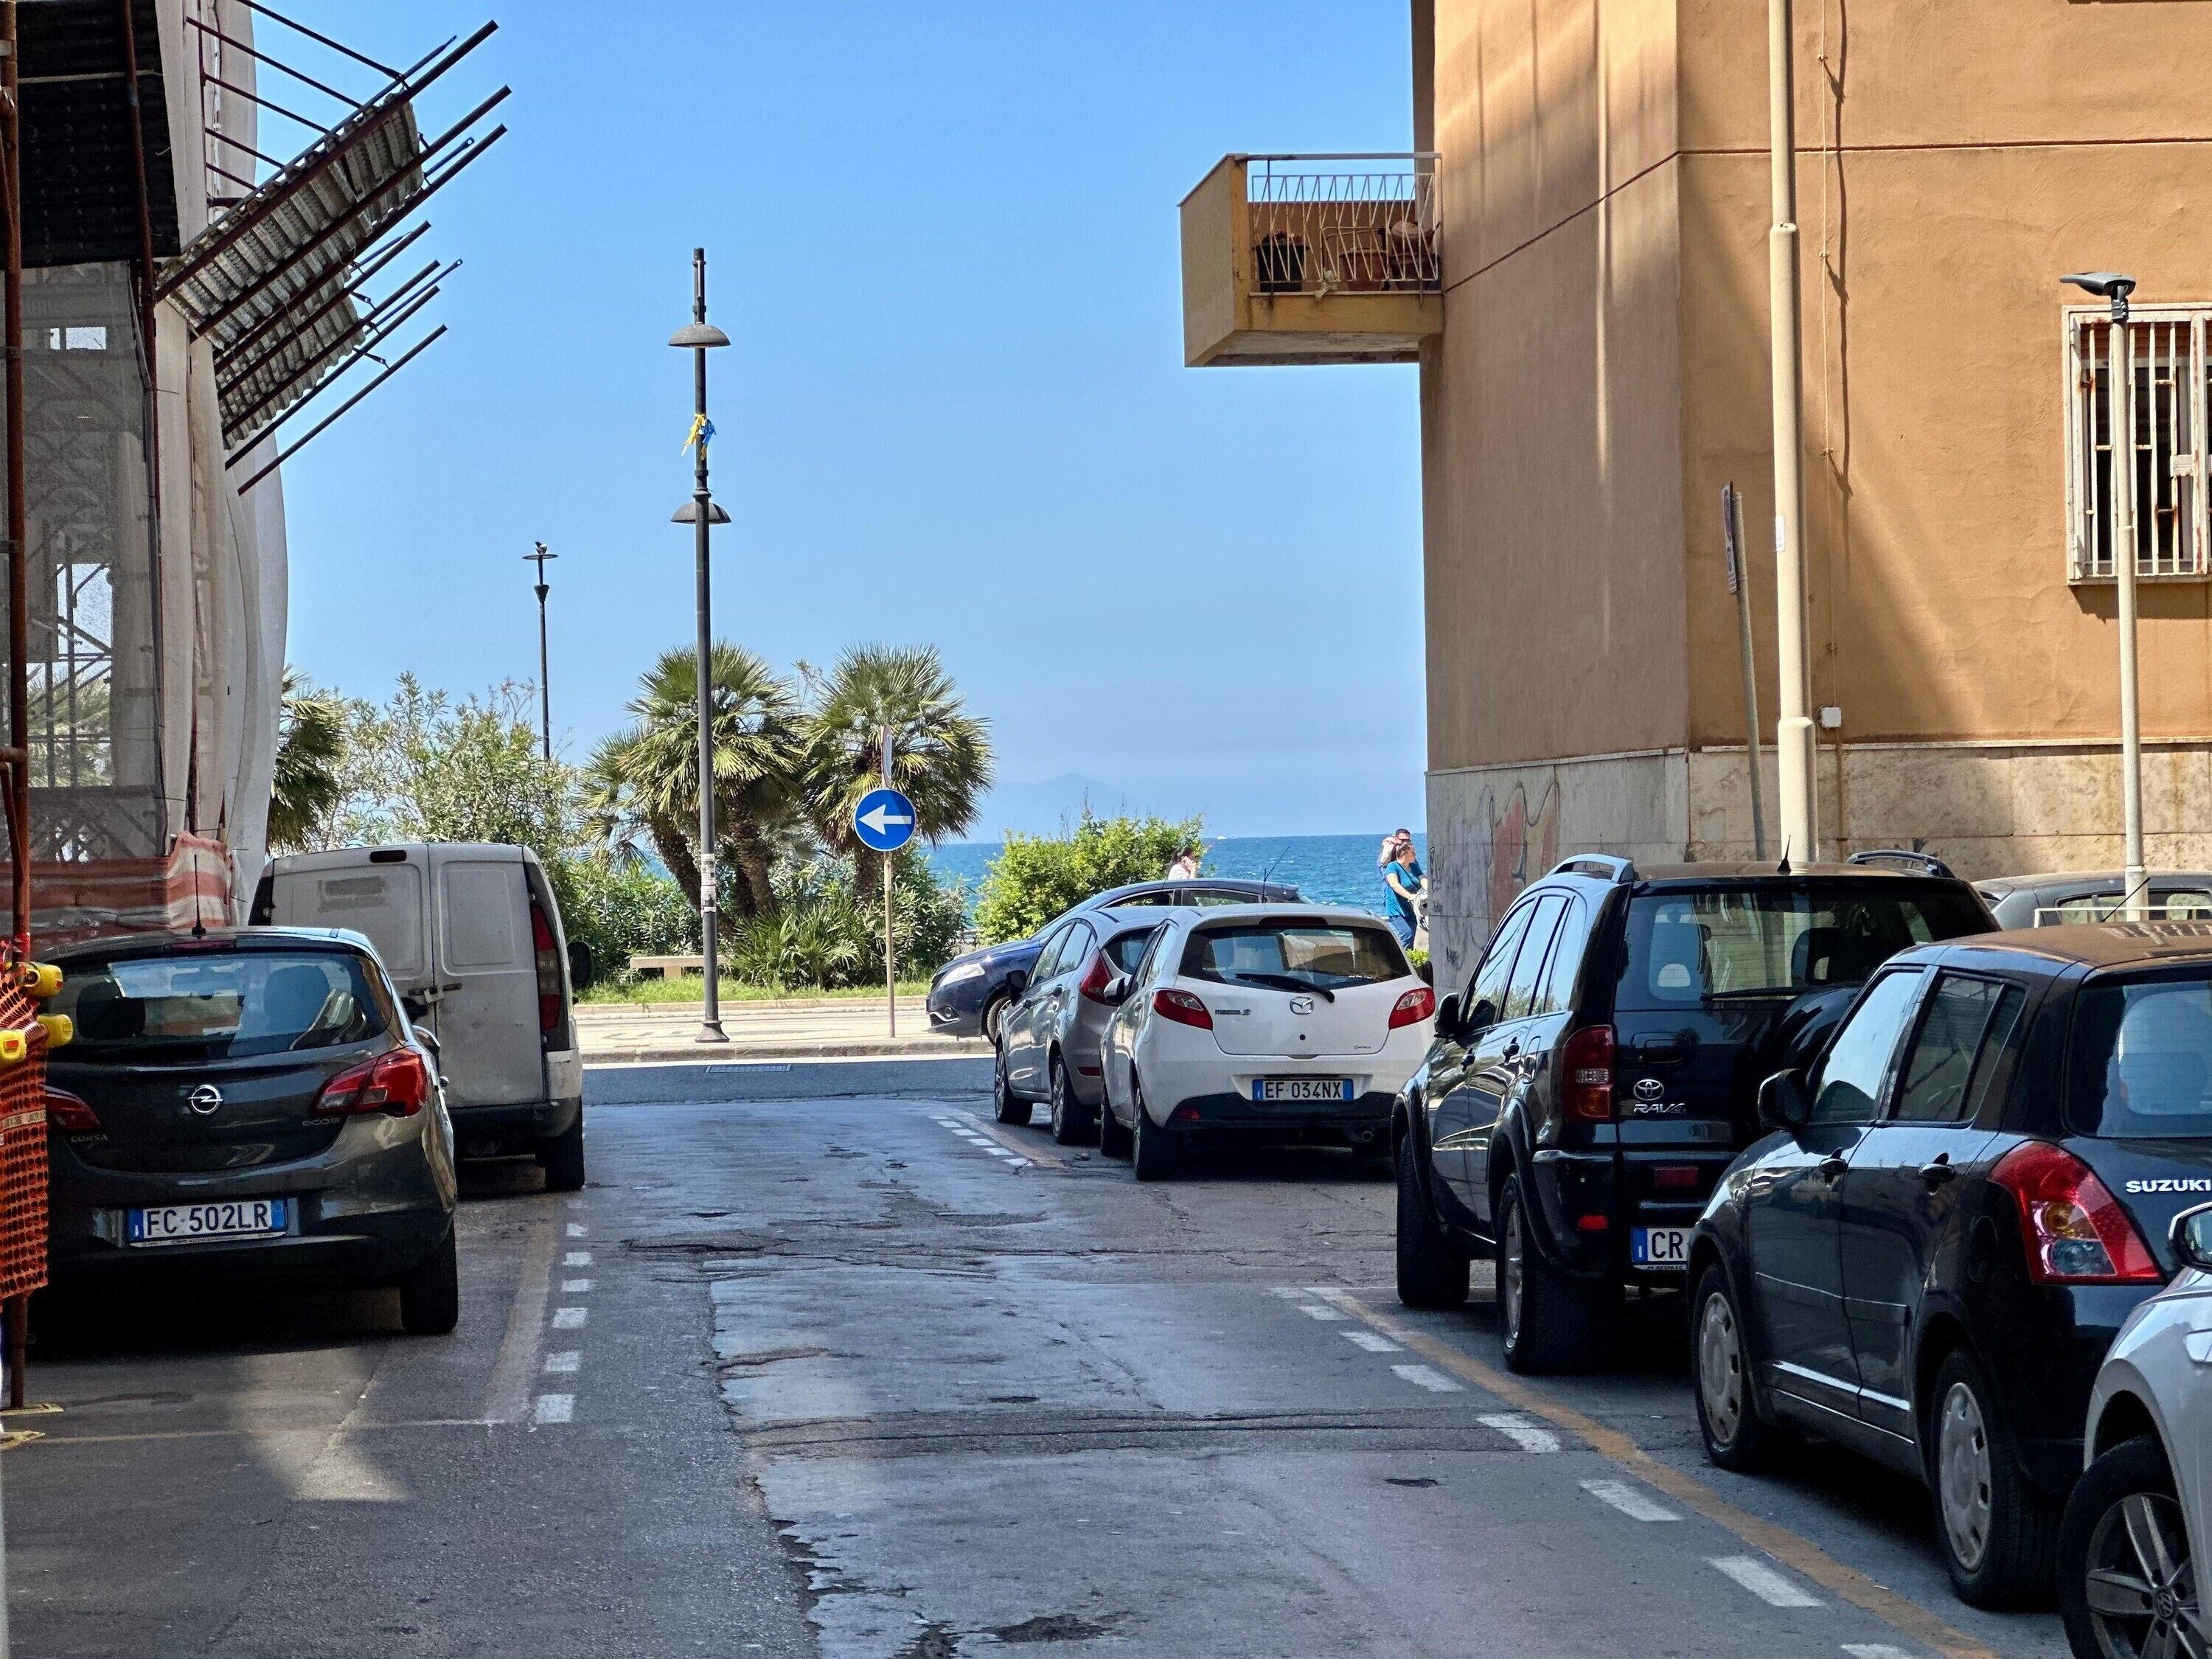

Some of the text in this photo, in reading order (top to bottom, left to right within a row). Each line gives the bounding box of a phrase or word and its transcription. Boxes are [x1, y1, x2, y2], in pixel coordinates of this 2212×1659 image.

[1265, 1082, 1284, 1098] EF
[1291, 1082, 1341, 1099] 034NX
[1633, 1102, 1686, 1114] RAV4
[2125, 1179, 2211, 1194] SUZUKI
[147, 1209, 178, 1236] FC
[189, 1203, 268, 1232] 502LR
[1652, 1231, 1683, 1259] CR
